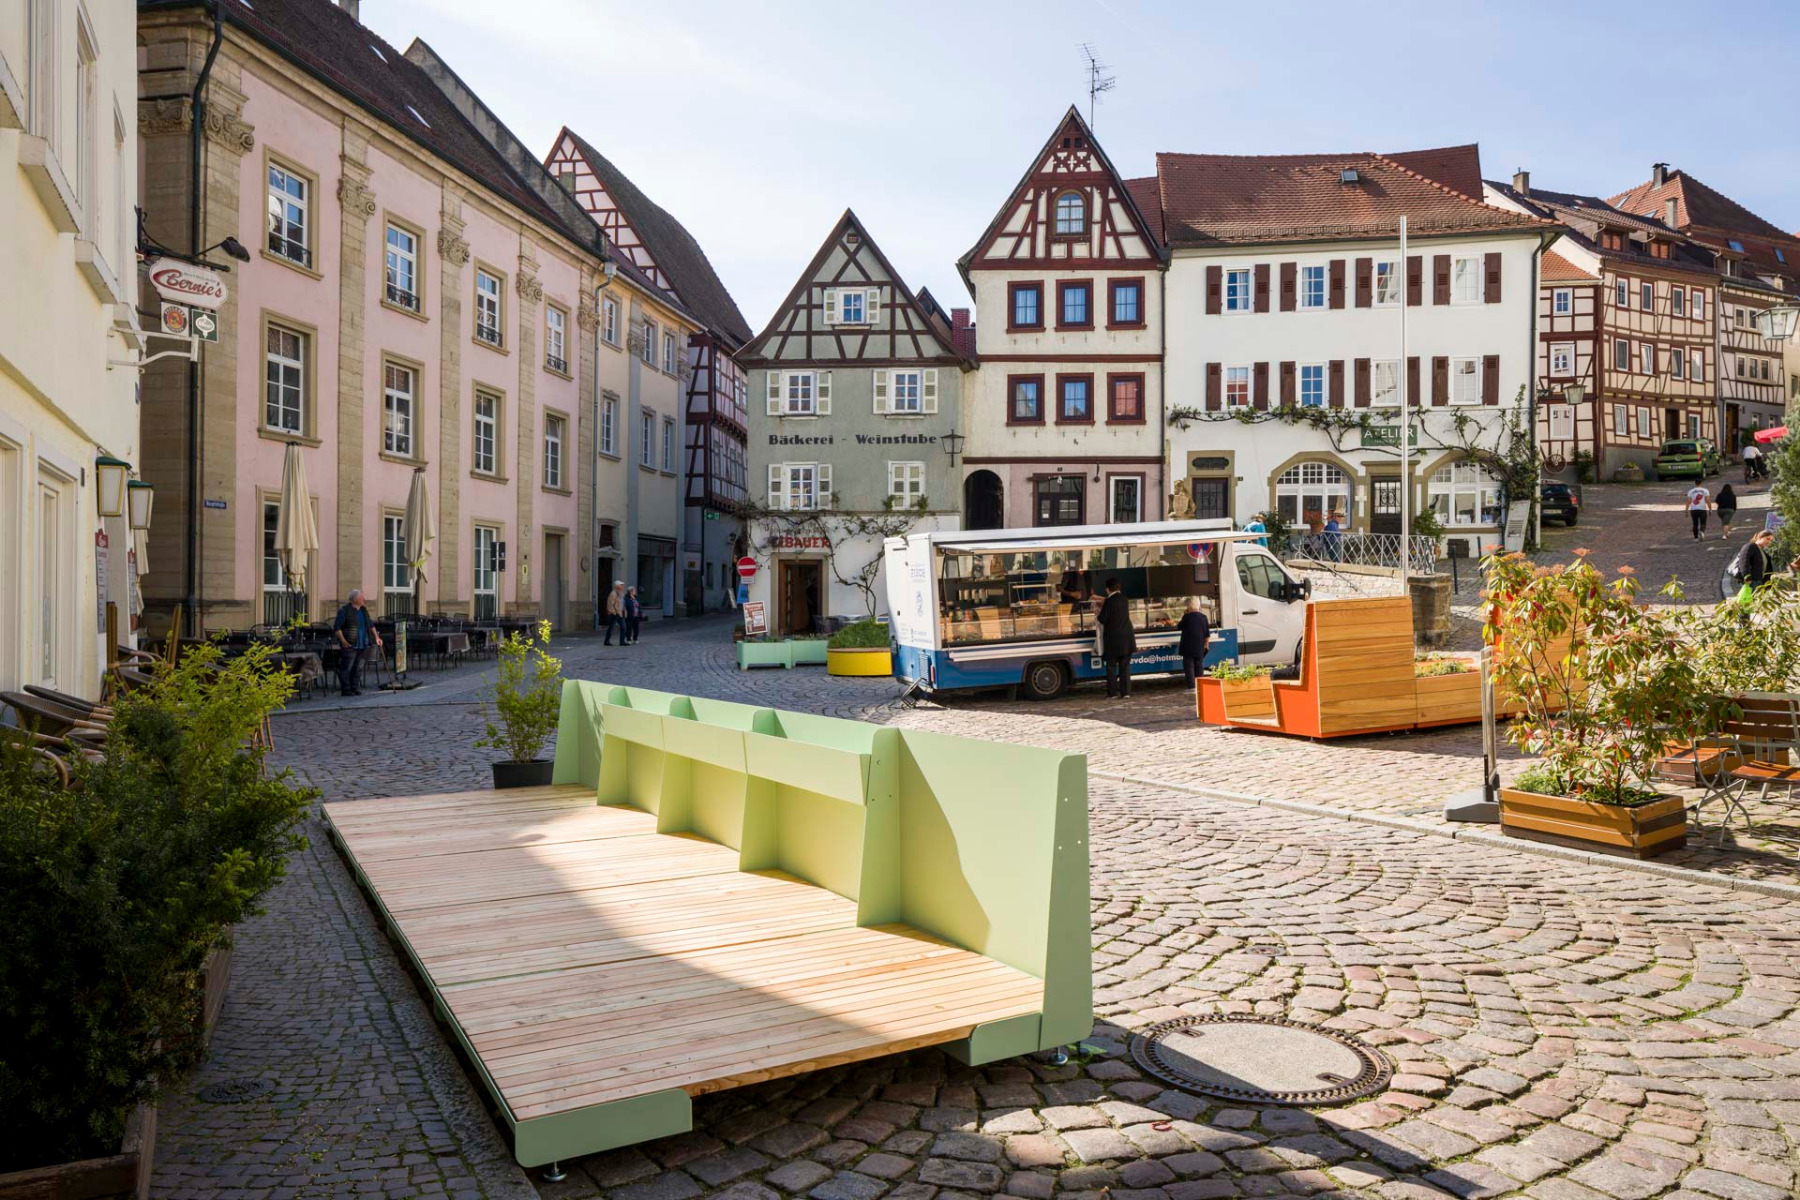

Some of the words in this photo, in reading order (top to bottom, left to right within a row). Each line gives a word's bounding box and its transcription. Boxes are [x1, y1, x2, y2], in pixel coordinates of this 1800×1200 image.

[153, 269, 222, 298] Bernie's
[769, 434, 834, 445] Bäckerei
[855, 433, 937, 445] Weinstube
[1364, 428, 1414, 438] AELIR
